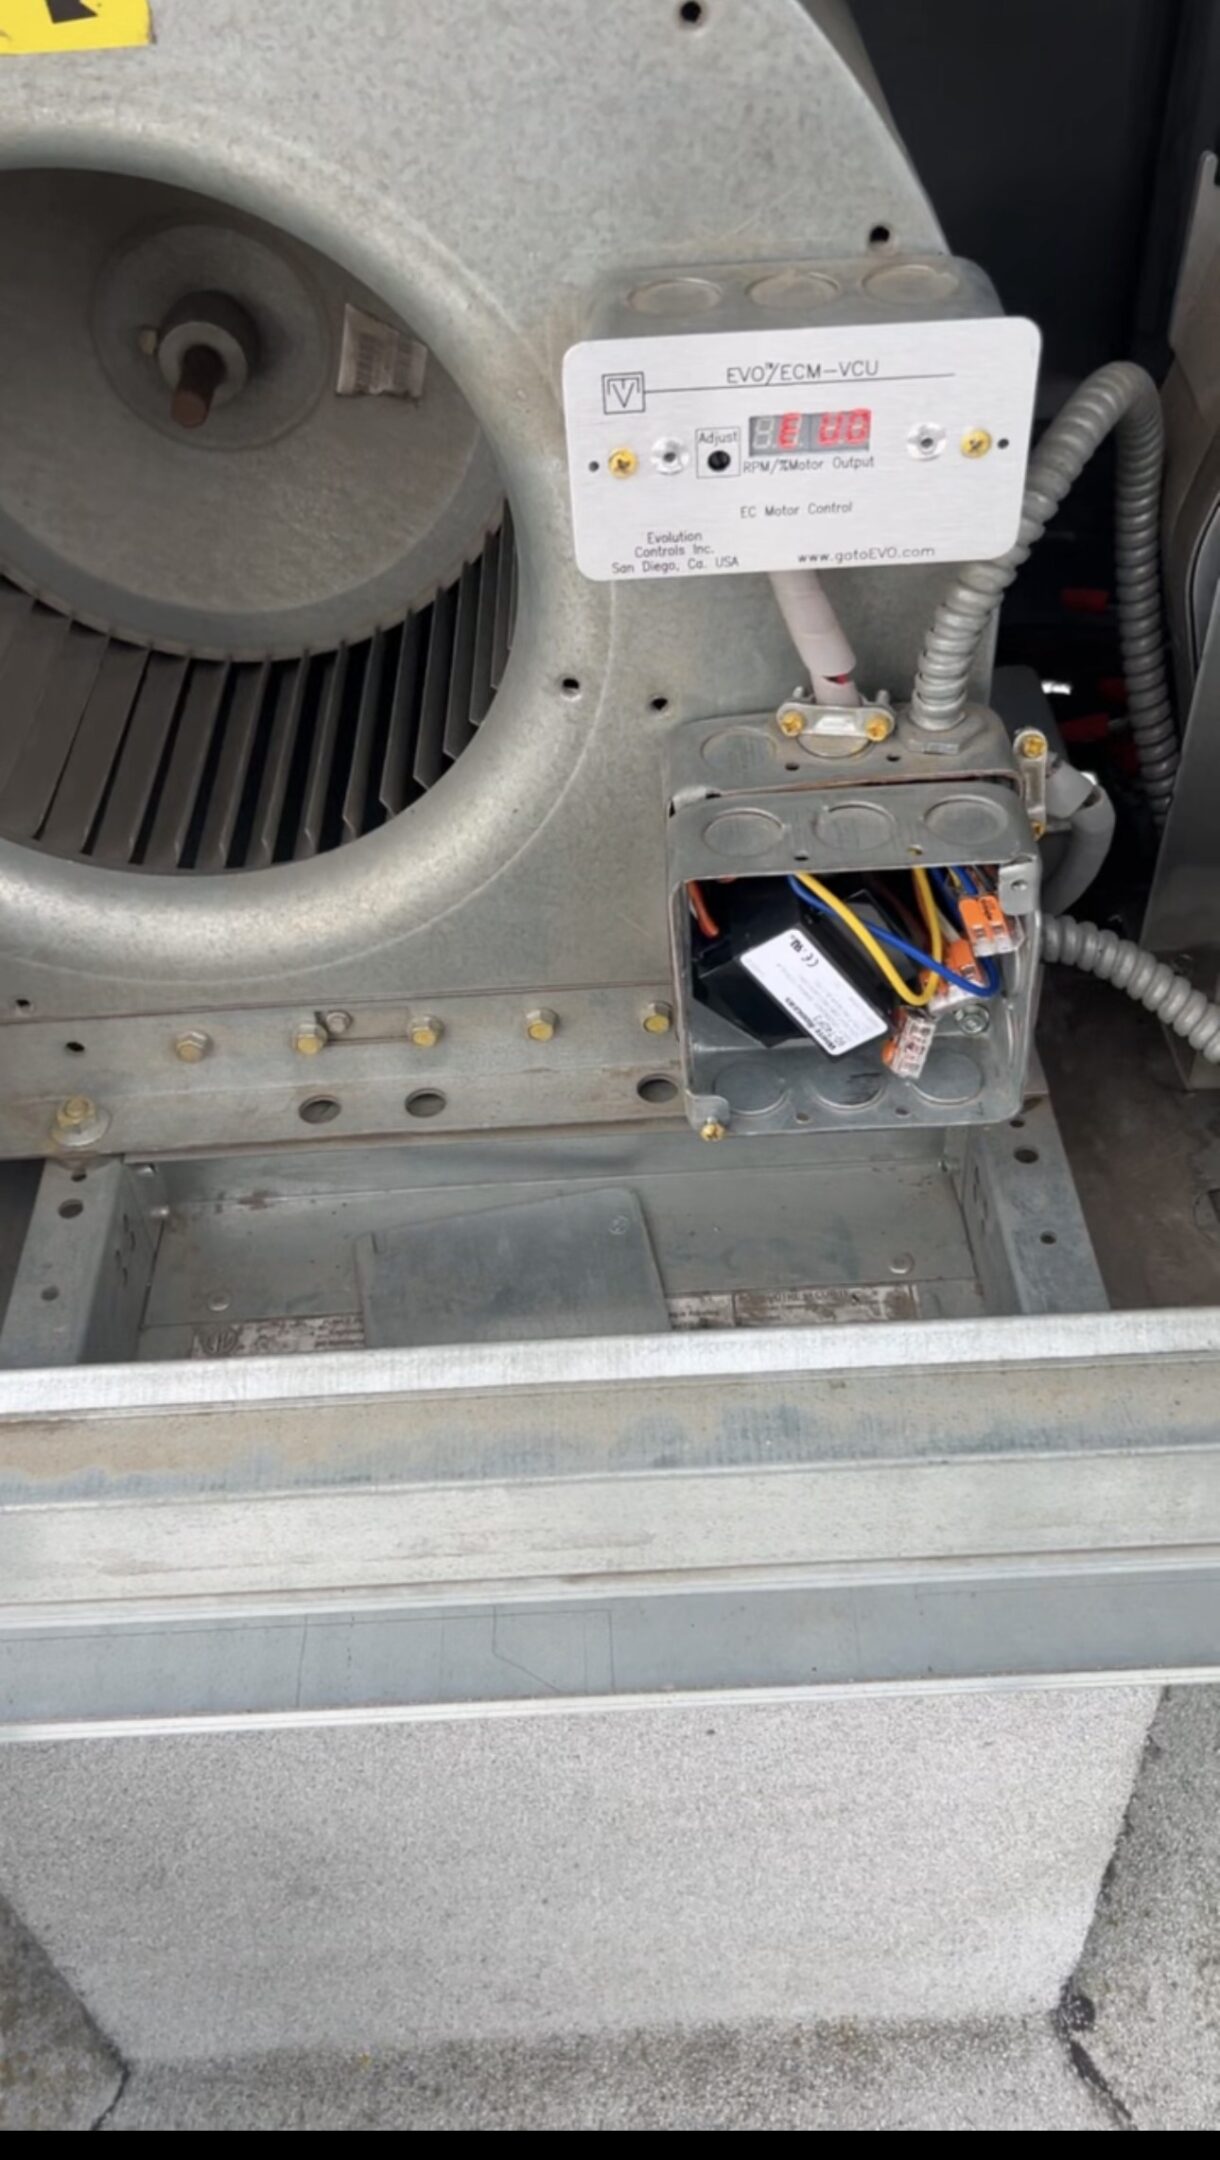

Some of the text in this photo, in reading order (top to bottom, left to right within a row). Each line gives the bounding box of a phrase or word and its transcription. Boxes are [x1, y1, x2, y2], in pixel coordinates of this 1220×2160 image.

[698, 430, 738, 446] Adjust
[832, 456, 875, 471] Output
[740, 501, 853, 518] EC Motor Control
[647, 531, 703, 545] Evolution
[634, 543, 715, 558] Controls Inc.
[798, 546, 936, 564] www.gotoEVO.com
[611, 562, 635, 575] San
[642, 559, 680, 574] Diego,
[715, 555, 740, 568] USA
